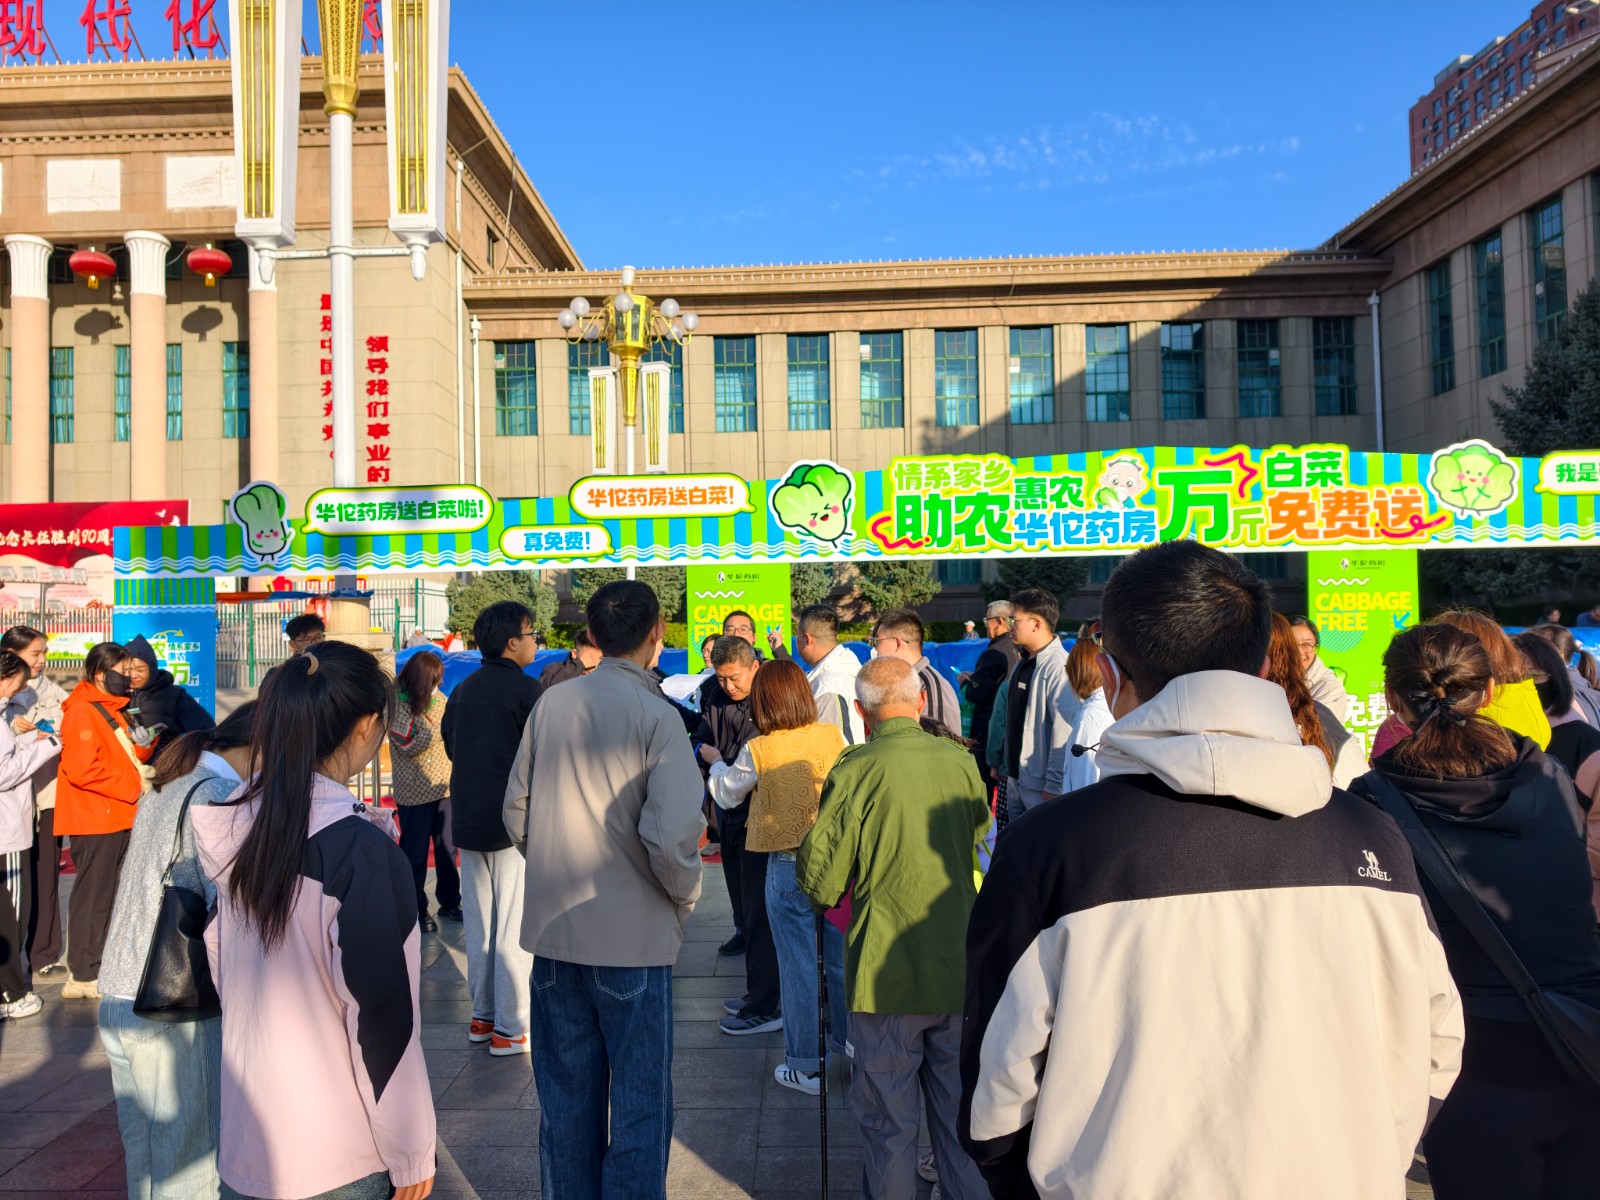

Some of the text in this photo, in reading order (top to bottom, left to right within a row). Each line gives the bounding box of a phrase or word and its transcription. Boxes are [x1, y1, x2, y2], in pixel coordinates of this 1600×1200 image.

[365, 335, 390, 483] 领导我们事业的
[894, 459, 1011, 491] 情系家乡
[1266, 451, 1343, 488] 白菜
[1556, 462, 1600, 483] 我是
[1014, 476, 1085, 509] 惠农
[895, 492, 1013, 548] 助农
[1014, 510, 1157, 546] 华佗药房
[1268, 488, 1426, 541] 免费送
[0, 527, 113, 548] 念长征胜利90周
[1315, 591, 1413, 611] CABBAGE
[1315, 611, 1369, 632] FREE
[1357, 866, 1393, 882] CAMEL
